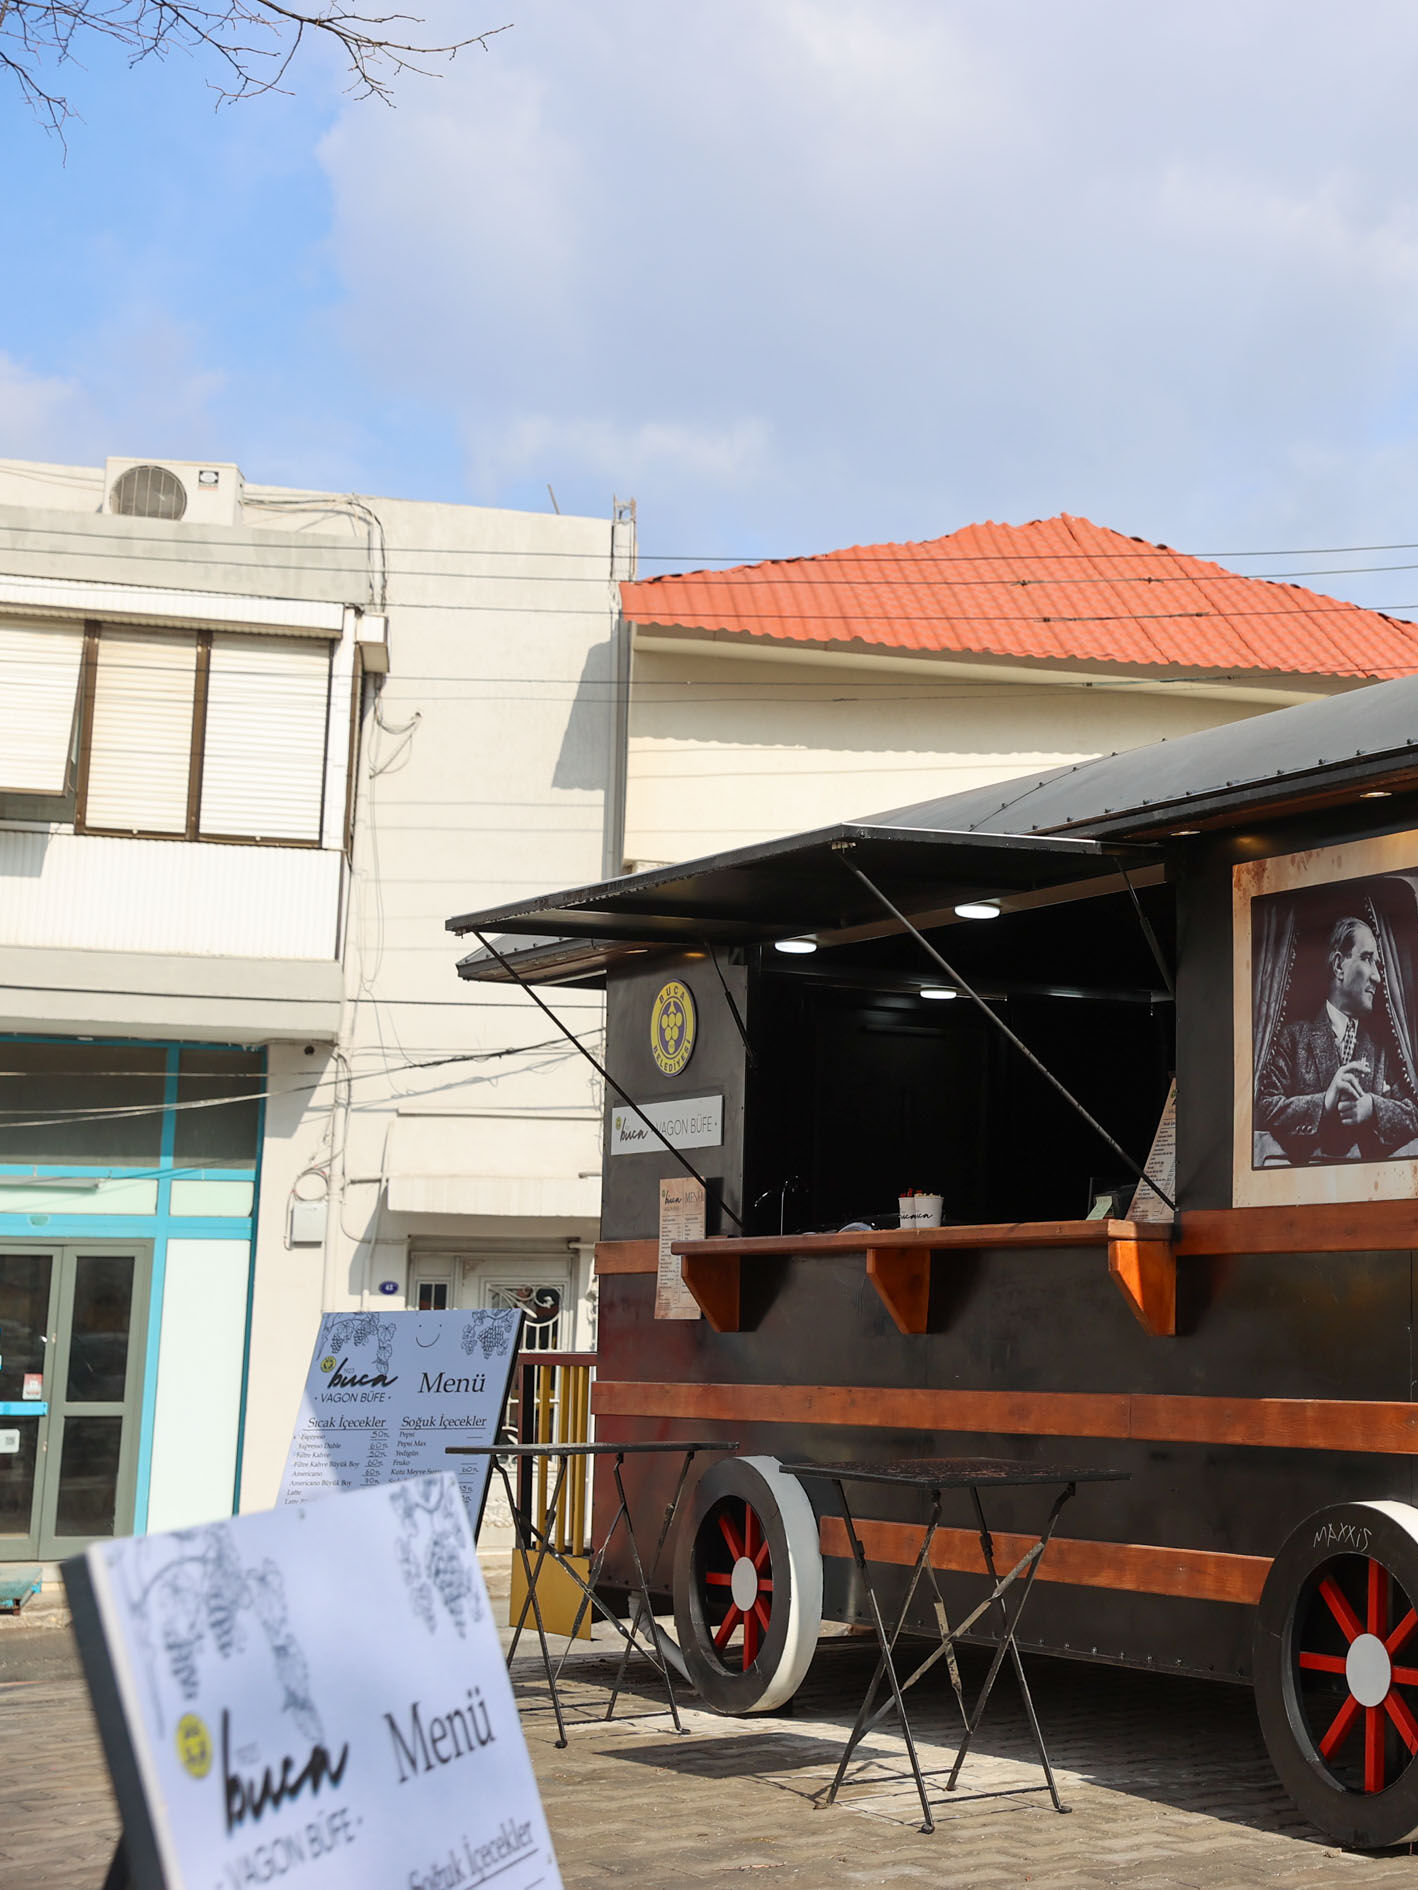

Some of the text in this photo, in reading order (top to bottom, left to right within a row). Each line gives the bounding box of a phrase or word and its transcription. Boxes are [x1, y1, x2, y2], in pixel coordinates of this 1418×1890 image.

[658, 986, 685, 1004] BUCA
[619, 1115, 648, 1142] buca
[690, 1114, 712, 1134] BÜFE
[328, 1357, 487, 1393] buca Menü
[321, 1391, 386, 1403] VAGON BÜFE
[307, 1413, 387, 1430] Sıcak İçecekler
[402, 1413, 487, 1430] Soğuk İçecekler
[221, 1686, 496, 1840] buca Menü
[225, 1830, 305, 1890] VAGON
[464, 1818, 535, 1878] İçecekler
